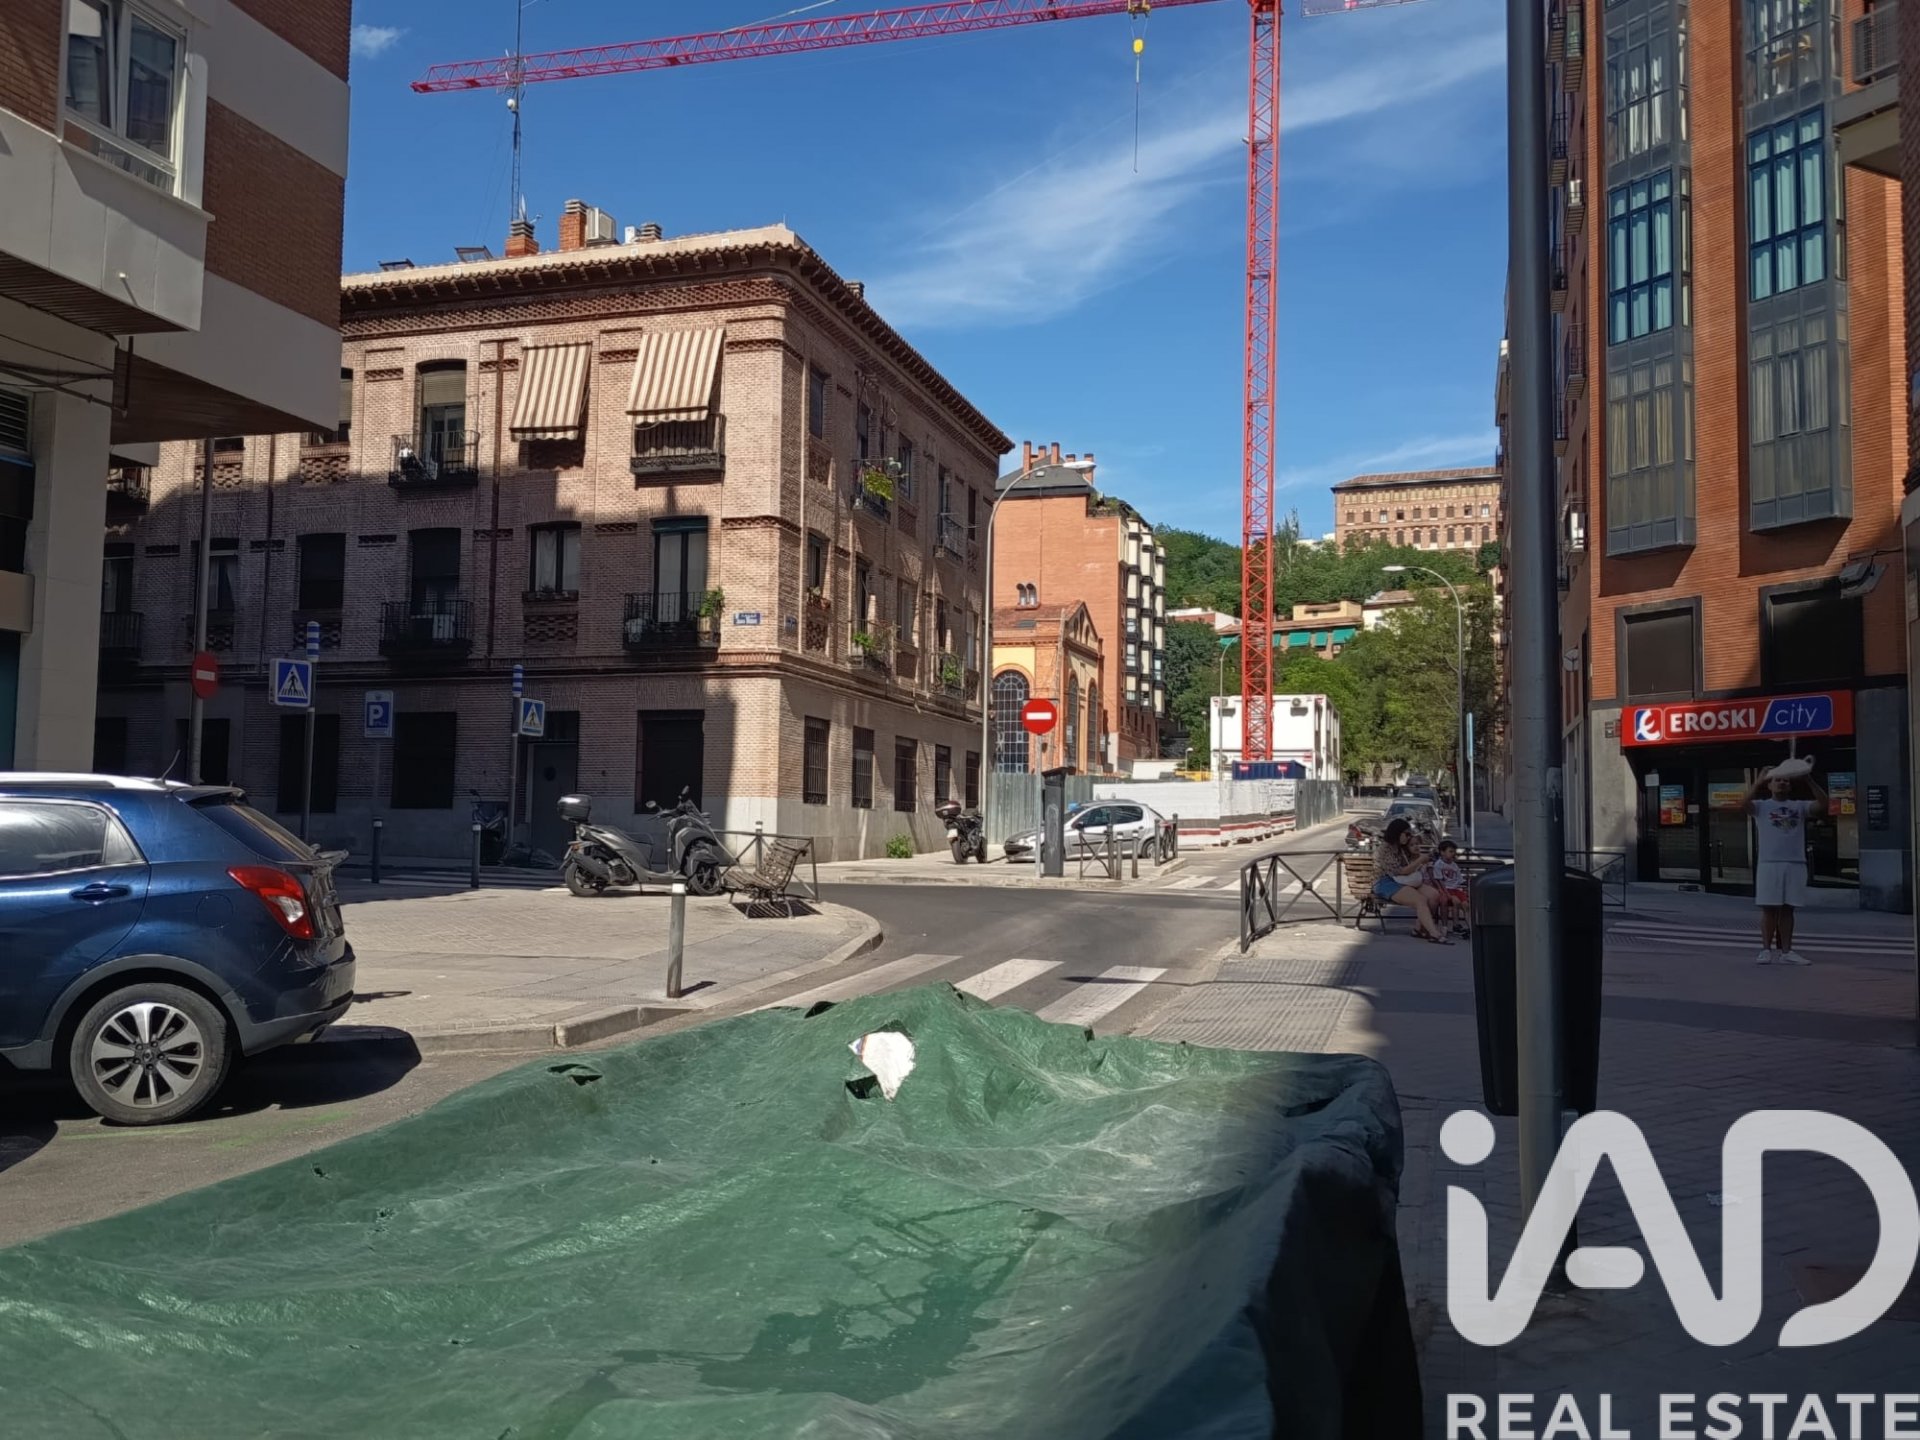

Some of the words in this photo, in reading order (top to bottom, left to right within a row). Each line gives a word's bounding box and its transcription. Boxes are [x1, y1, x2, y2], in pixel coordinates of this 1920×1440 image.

[368, 704, 384, 727] P
[1670, 708, 1755, 733] EROSKI
[1775, 703, 1817, 728] city
